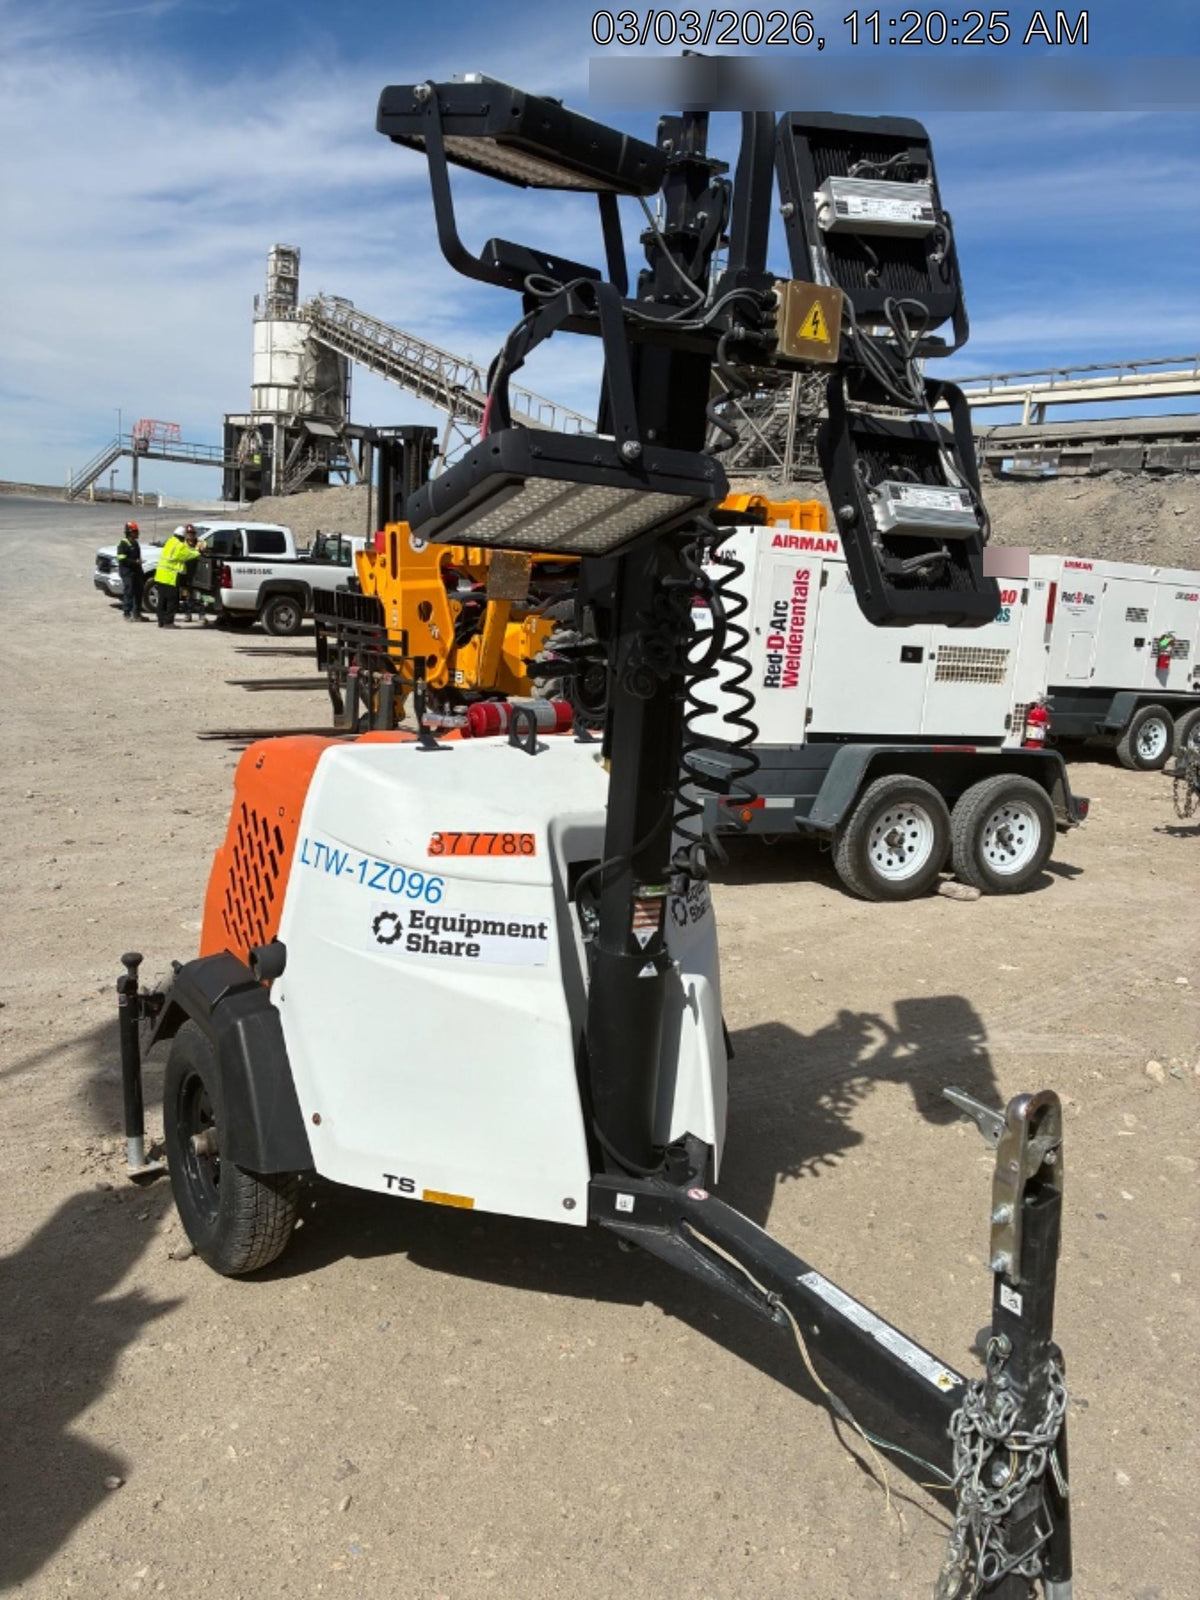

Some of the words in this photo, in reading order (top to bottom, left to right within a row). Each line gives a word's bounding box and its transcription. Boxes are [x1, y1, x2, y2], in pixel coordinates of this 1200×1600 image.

[771, 533, 838, 553] AIRMAN
[782, 568, 811, 689] Welderentals
[428, 832, 535, 855] 377786
[299, 838, 445, 904] LTW-1Z096
[408, 909, 549, 940] Equipment
[405, 932, 482, 958] Share
[382, 1173, 415, 1193] TS
